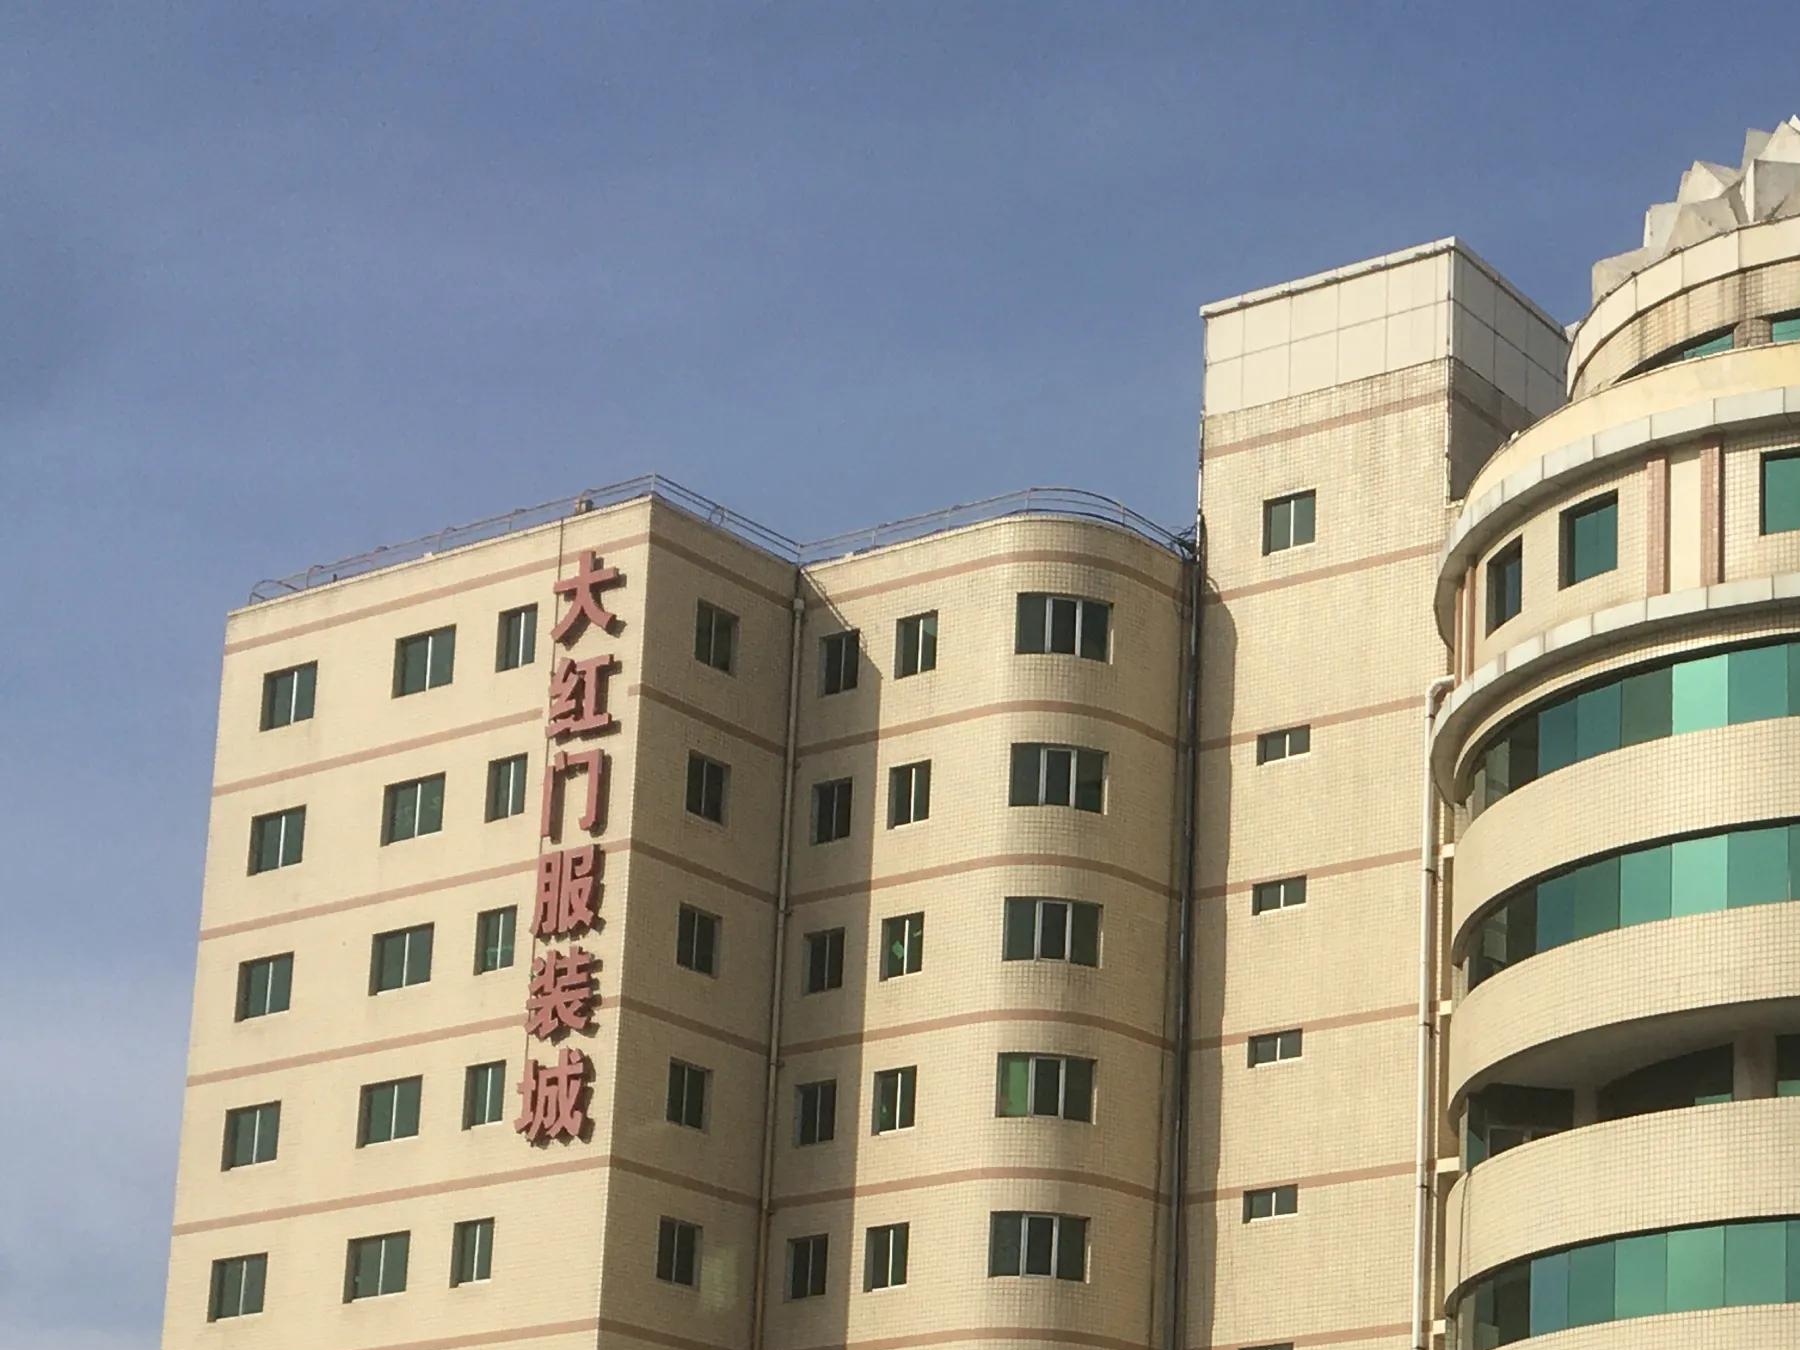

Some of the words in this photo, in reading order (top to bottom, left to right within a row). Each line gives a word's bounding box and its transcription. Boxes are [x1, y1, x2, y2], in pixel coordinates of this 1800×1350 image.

[514, 549, 622, 1143] 大红门服装城
